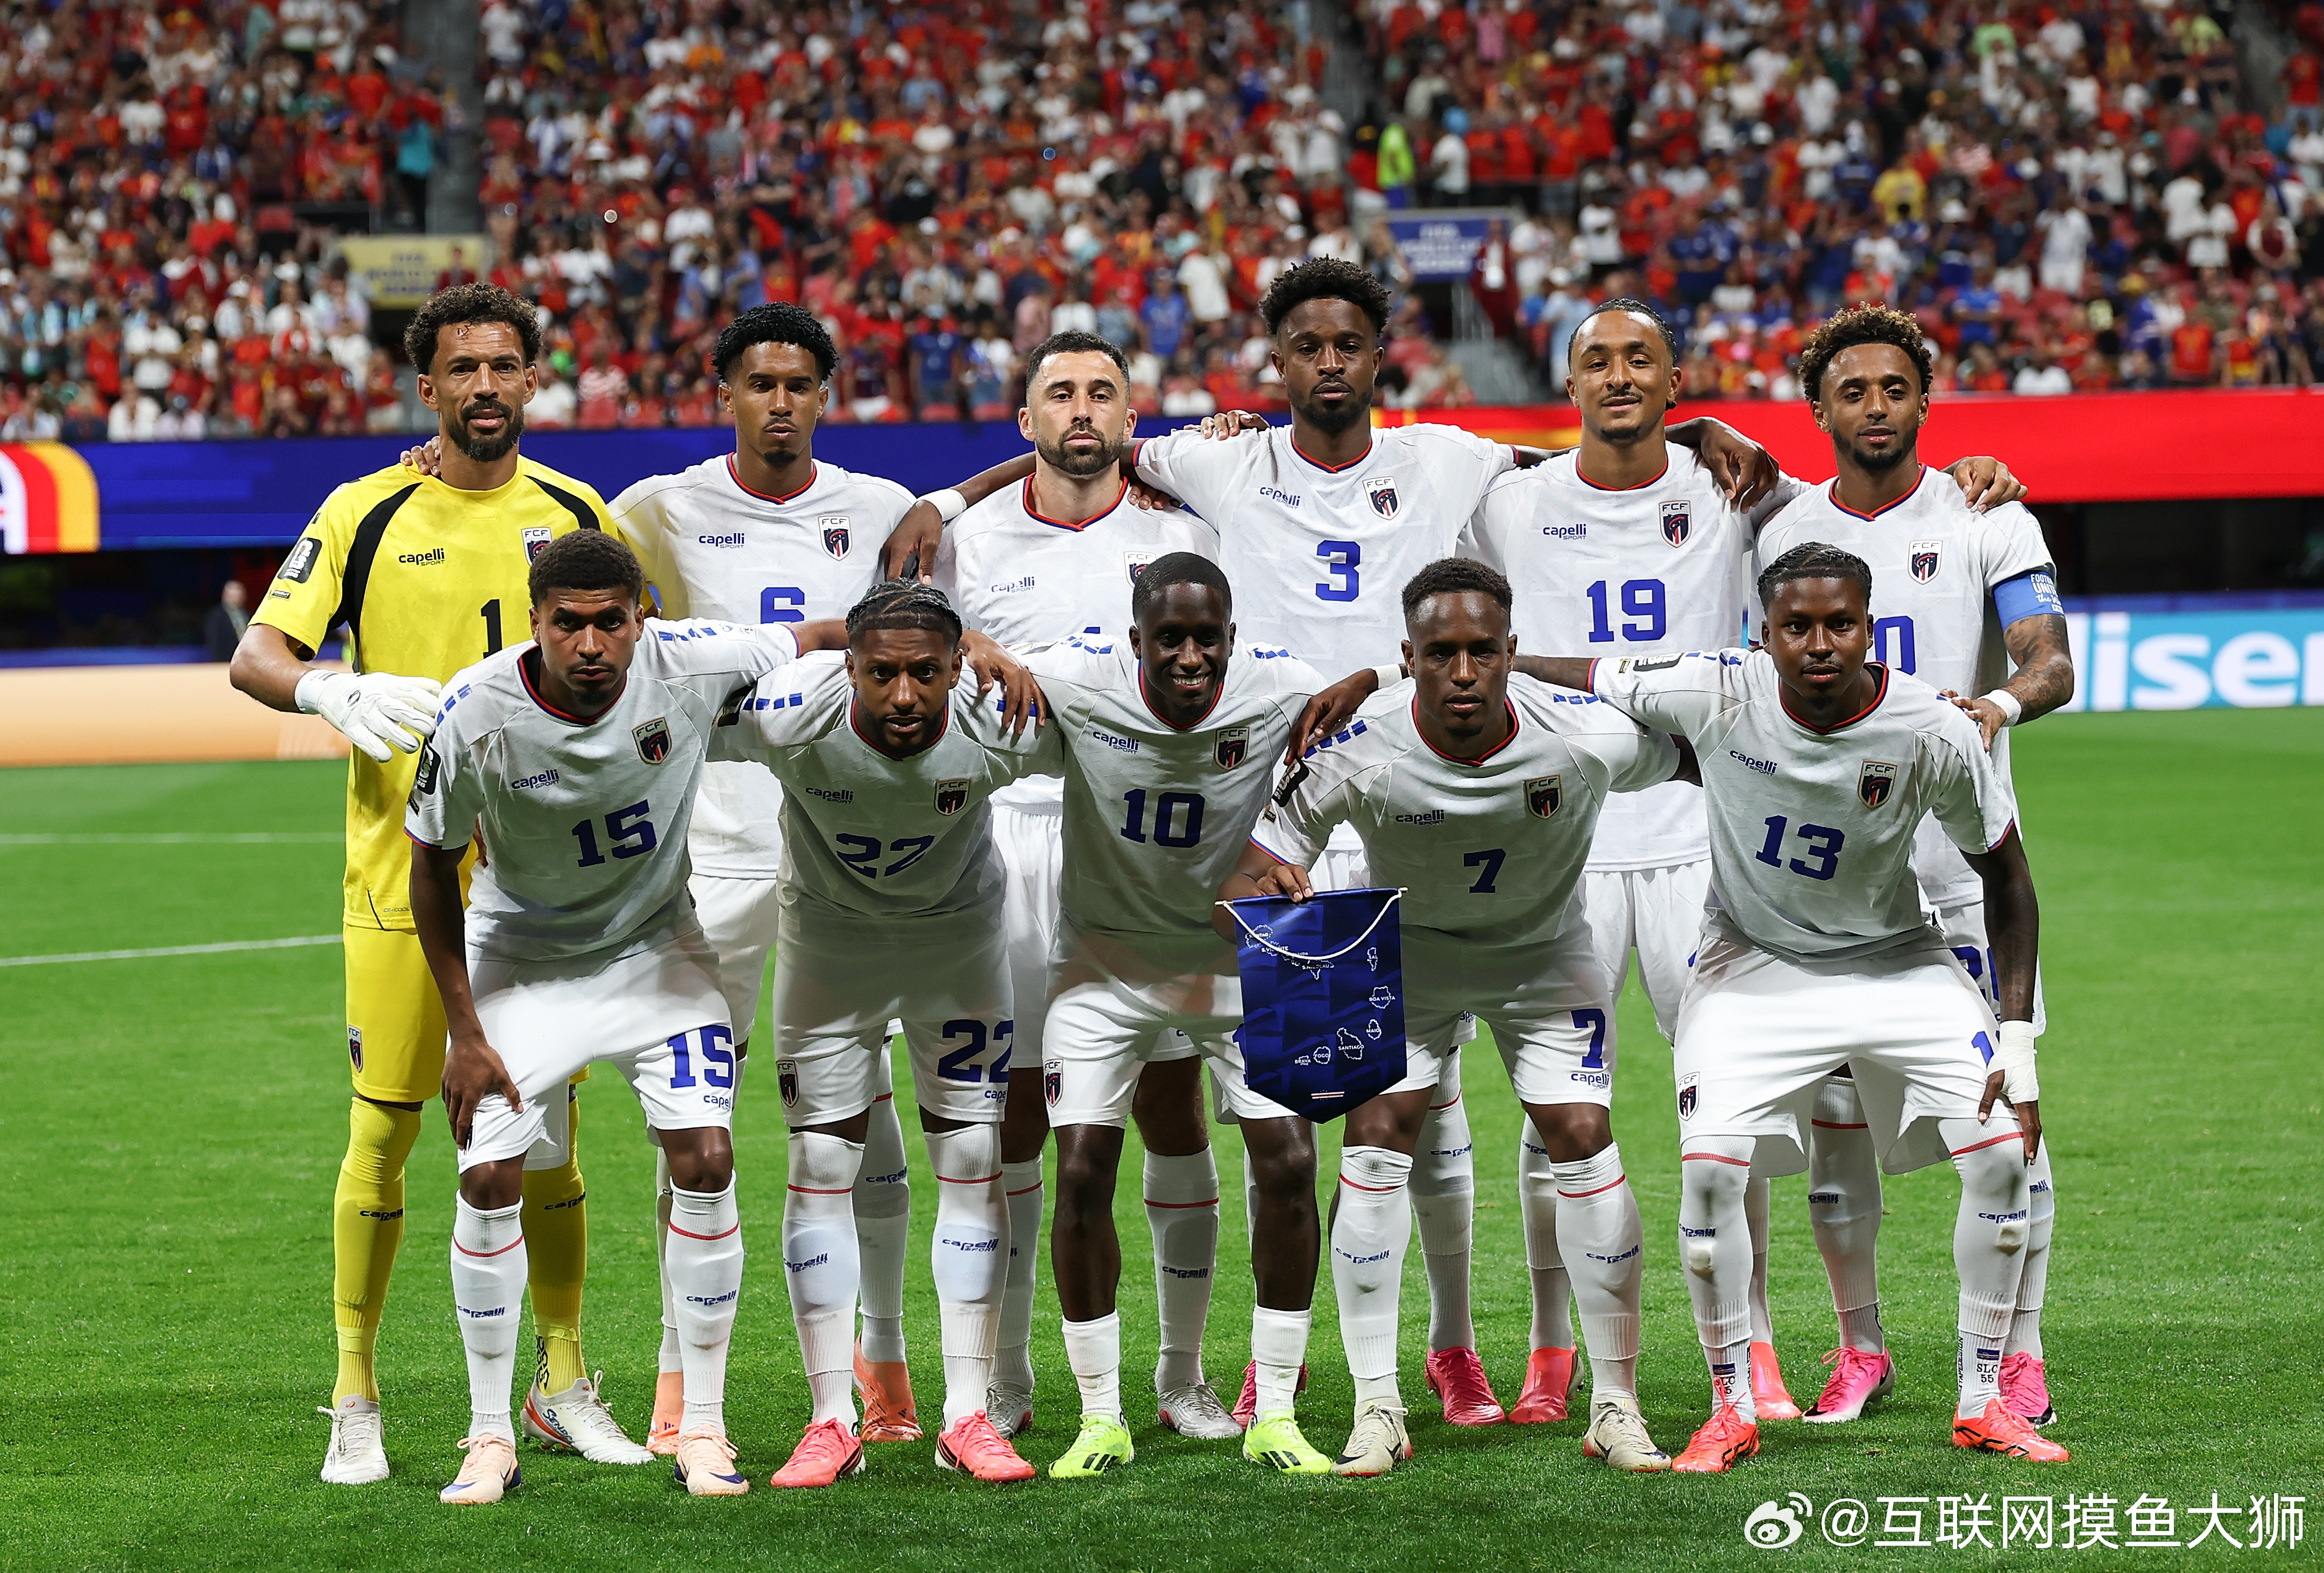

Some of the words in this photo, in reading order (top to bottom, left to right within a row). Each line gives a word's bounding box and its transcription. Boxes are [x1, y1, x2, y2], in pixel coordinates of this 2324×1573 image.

[1366, 479, 1392, 488] FCF
[1260, 486, 1301, 506] capelli
[1276, 498, 1299, 510] SPORT
[1662, 503, 1687, 511] FCF
[1543, 523, 1586, 538] capelli
[699, 533, 745, 547] capelli
[399, 548, 445, 565] capelli
[1315, 540, 1361, 602] 3
[991, 576, 1035, 593] capelli
[2032, 583, 2058, 598] UNITE
[1586, 578, 1666, 643] 19
[480, 599, 502, 659] 1
[1874, 615, 1916, 675] 0
[636, 721, 663, 737] FCF
[1219, 729, 1246, 738] FCF
[1093, 731, 1140, 751] capelli
[1113, 745, 1138, 754] SPORT
[1730, 749, 1777, 774] capelli
[1865, 764, 1893, 773] FCF
[1748, 765, 1774, 776] SPORT
[511, 769, 560, 790] capelli
[535, 780, 559, 789] SPORT
[1529, 778, 1557, 789] FCF
[805, 786, 854, 802] capelli
[1121, 788, 1205, 848] 10
[1395, 810, 1444, 824] capelli
[571, 799, 657, 868] 15
[1755, 814, 1846, 881] 13
[1463, 848, 1507, 894] 7
[348, 1028, 360, 1037] FCF
[1570, 1008, 1606, 1069] 7
[667, 1024, 734, 1088] 15
[937, 1019, 1014, 1082] 22
[777, 1062, 793, 1071] FCF
[1045, 1061, 1061, 1069] FCF
[1571, 1073, 1609, 1087] capelli
[1978, 1209, 2027, 1224] capelli
[943, 1238, 999, 1251] capelli
[686, 1289, 736, 1306] capelli
[1976, 1364, 1997, 1373] SLC
[1981, 1374, 1994, 1383] 55
